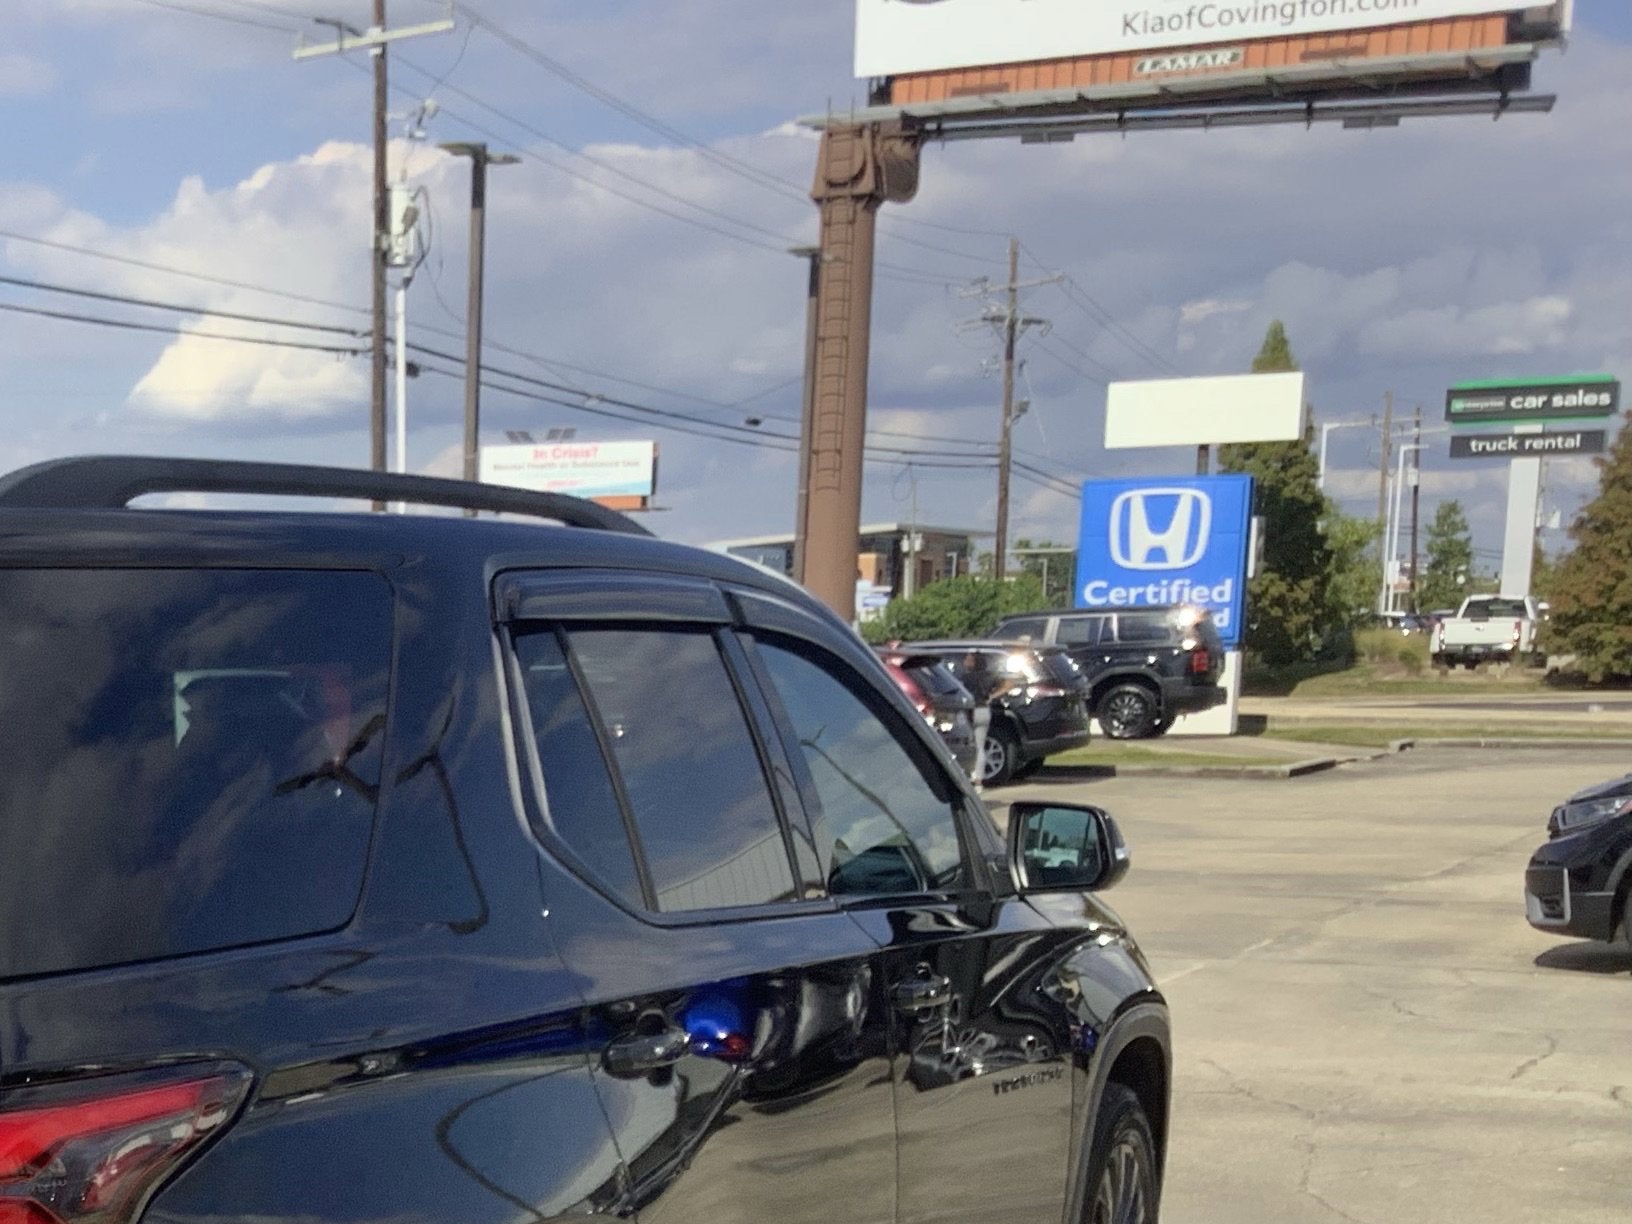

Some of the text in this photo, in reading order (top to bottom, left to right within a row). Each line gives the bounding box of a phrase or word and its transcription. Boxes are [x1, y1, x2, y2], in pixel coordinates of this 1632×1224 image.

[1139, 50, 1235, 74] LAMAR
[1510, 394, 1548, 409] car
[1551, 389, 1611, 408] sales
[1470, 434, 1581, 453] truck rental
[1083, 578, 1233, 605] Certified
